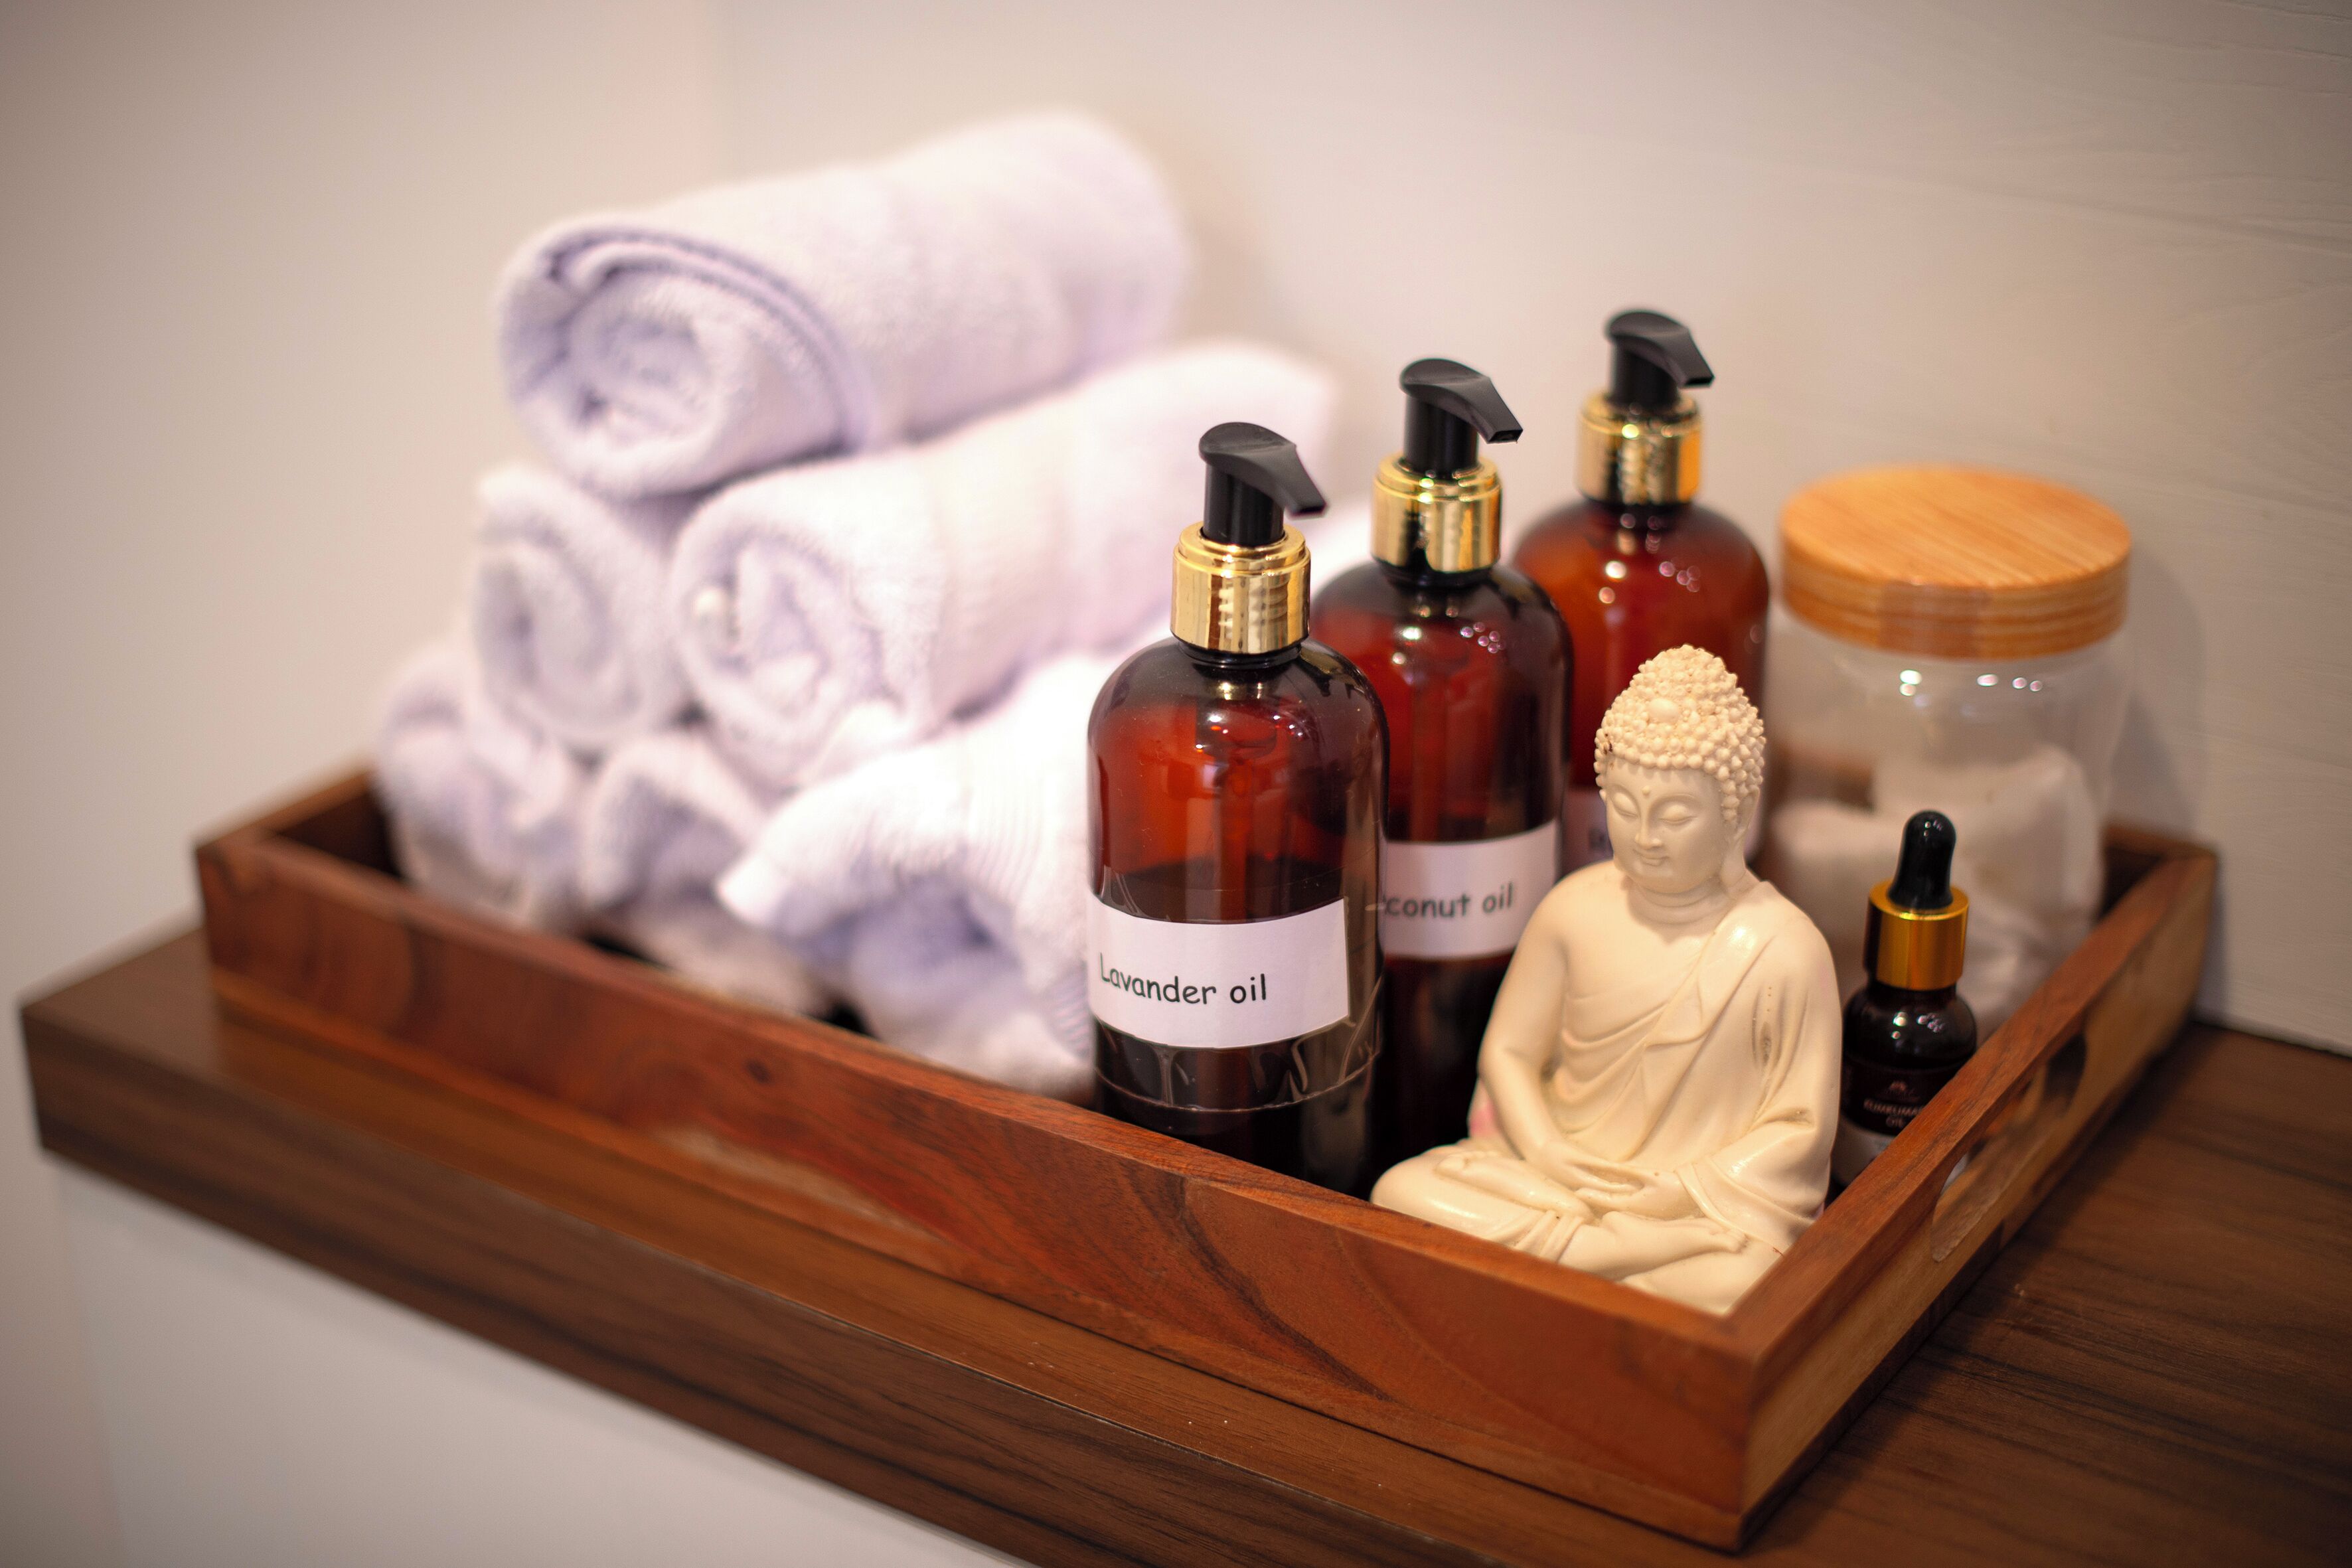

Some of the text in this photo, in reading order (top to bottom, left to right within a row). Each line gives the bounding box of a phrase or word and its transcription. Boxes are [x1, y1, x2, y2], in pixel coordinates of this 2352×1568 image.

[1382, 881, 1514, 919] conut oil
[1099, 952, 1267, 1005] Lavander oil
